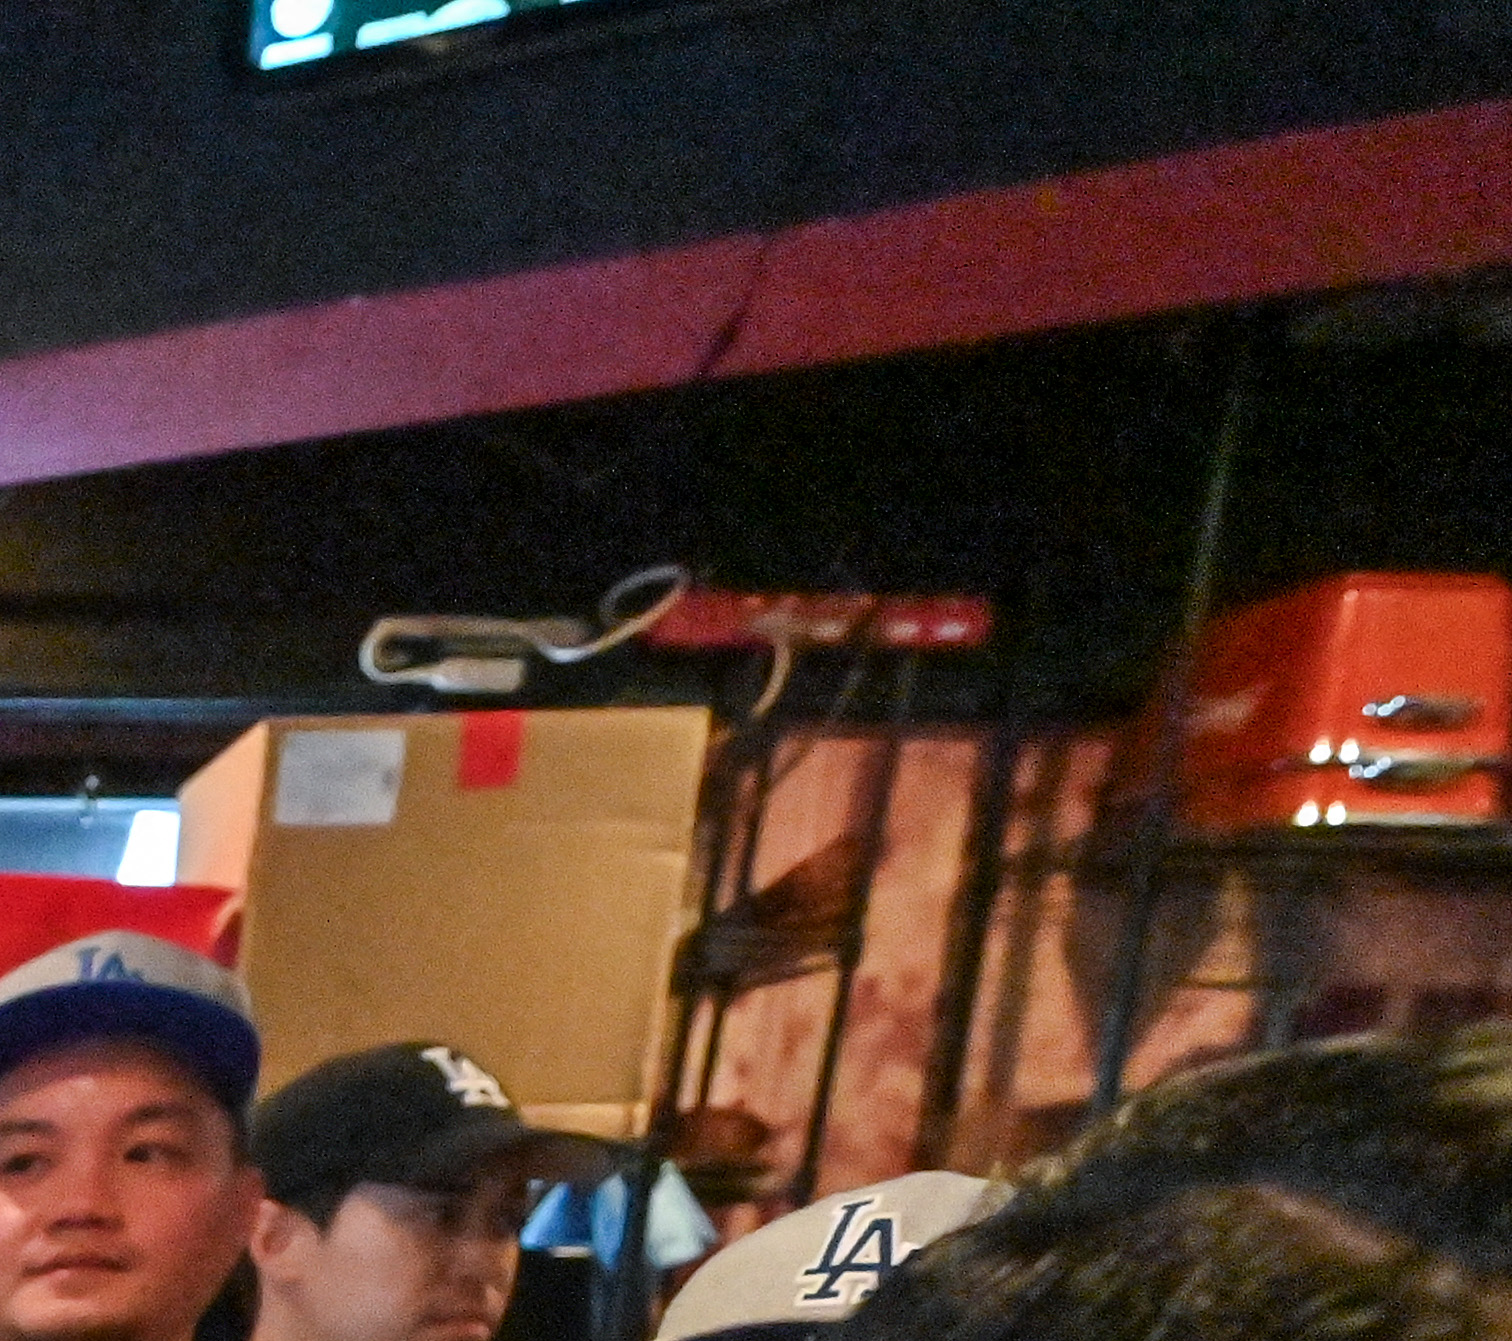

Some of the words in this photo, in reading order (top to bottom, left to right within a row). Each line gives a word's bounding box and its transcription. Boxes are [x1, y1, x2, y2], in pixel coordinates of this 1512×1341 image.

[75, 945, 143, 982] LA
[421, 1046, 511, 1108] LA
[802, 1198, 918, 1301] LA
